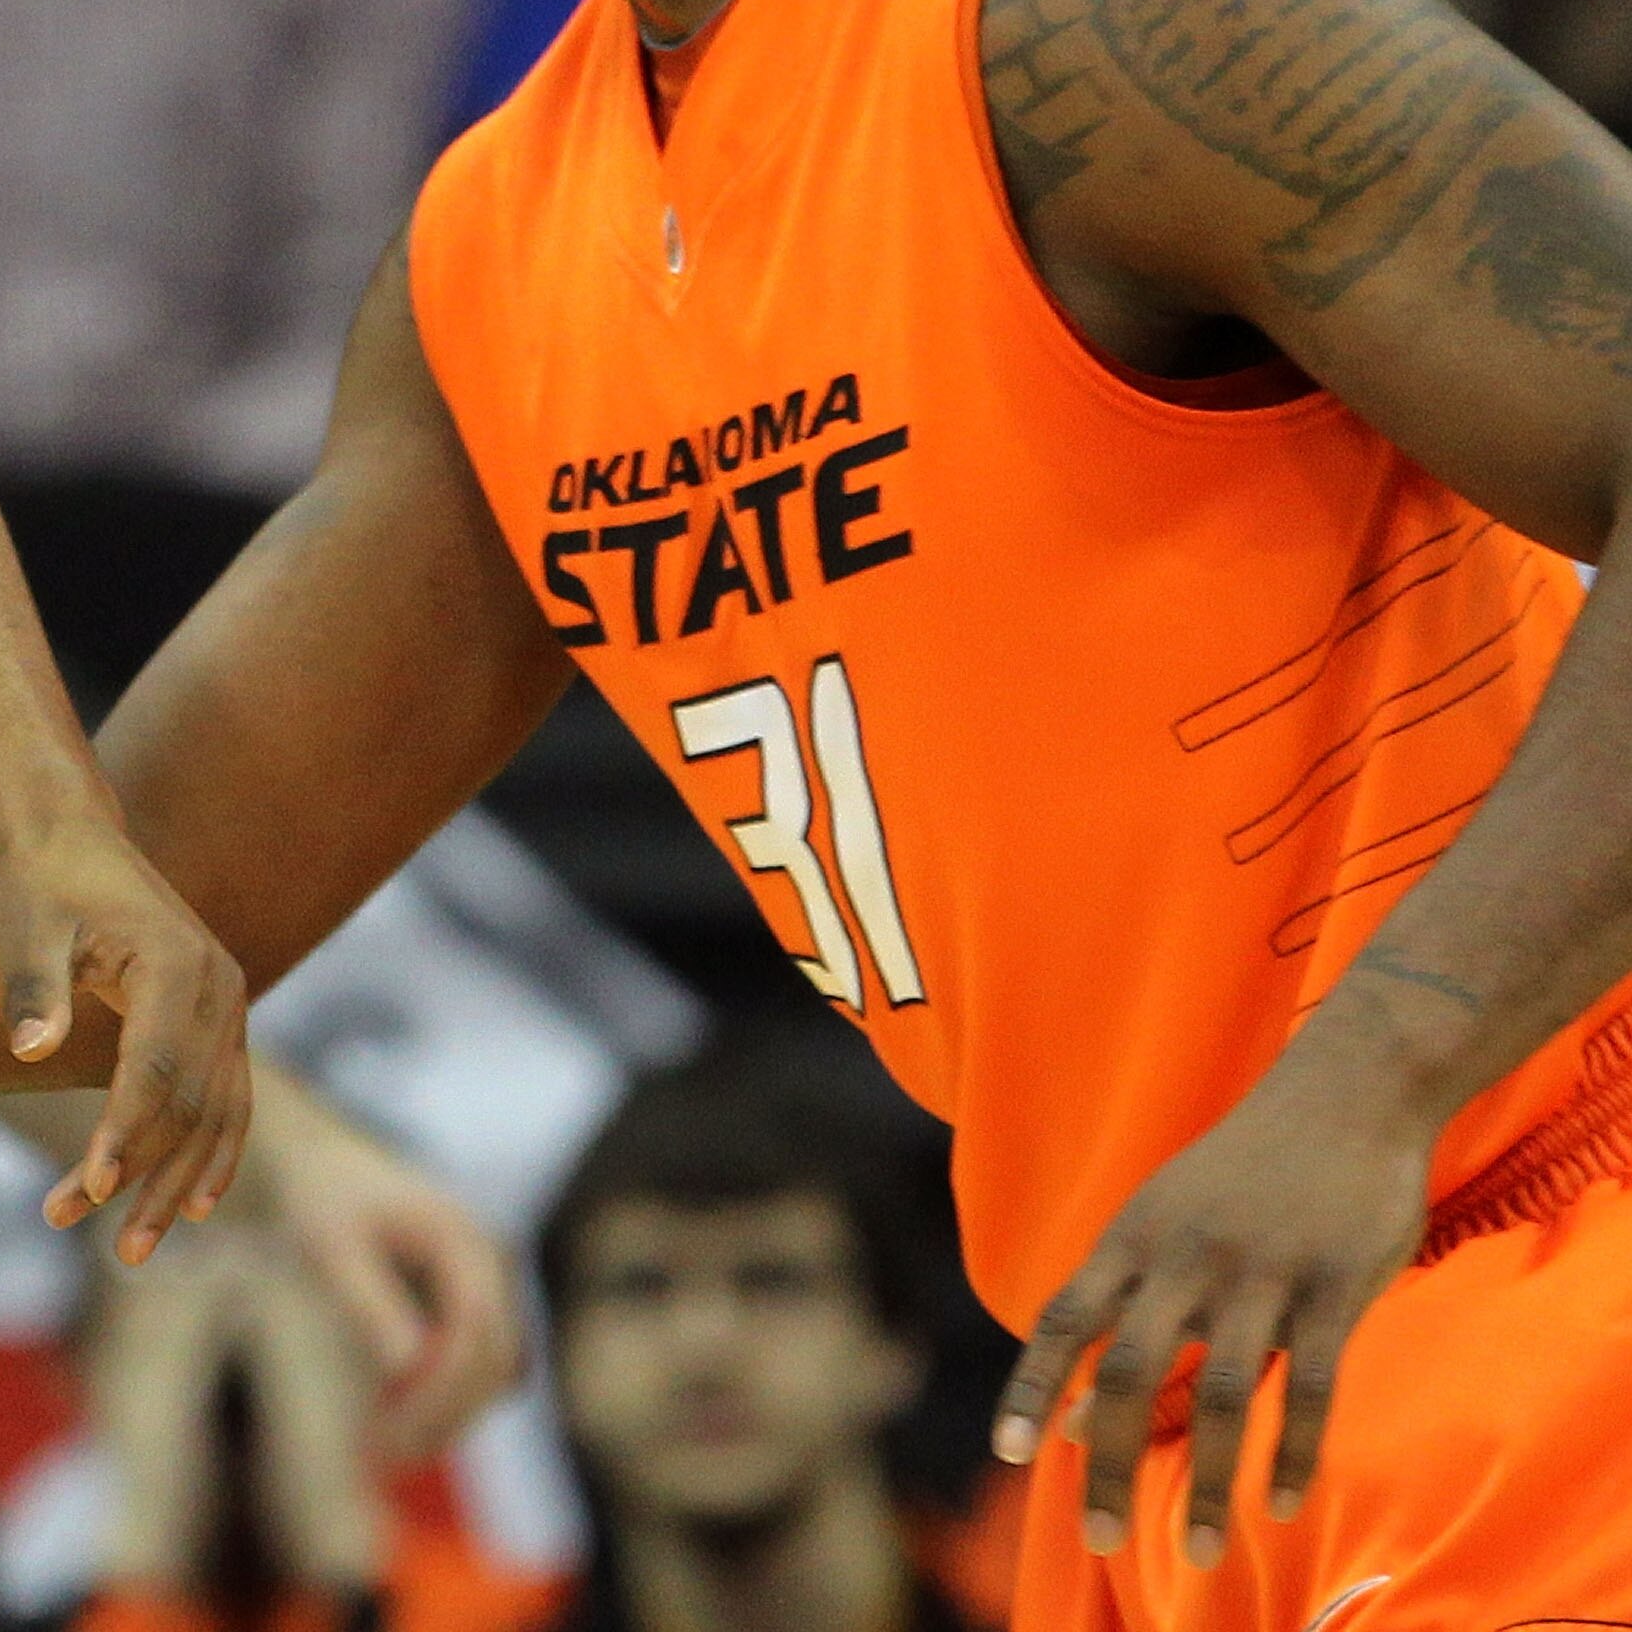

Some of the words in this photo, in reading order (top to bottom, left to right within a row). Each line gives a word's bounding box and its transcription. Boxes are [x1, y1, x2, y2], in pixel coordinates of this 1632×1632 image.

[540, 425, 914, 649] STATE
[547, 372, 863, 514] OKLAOMA
[671, 652, 929, 1016] 31
